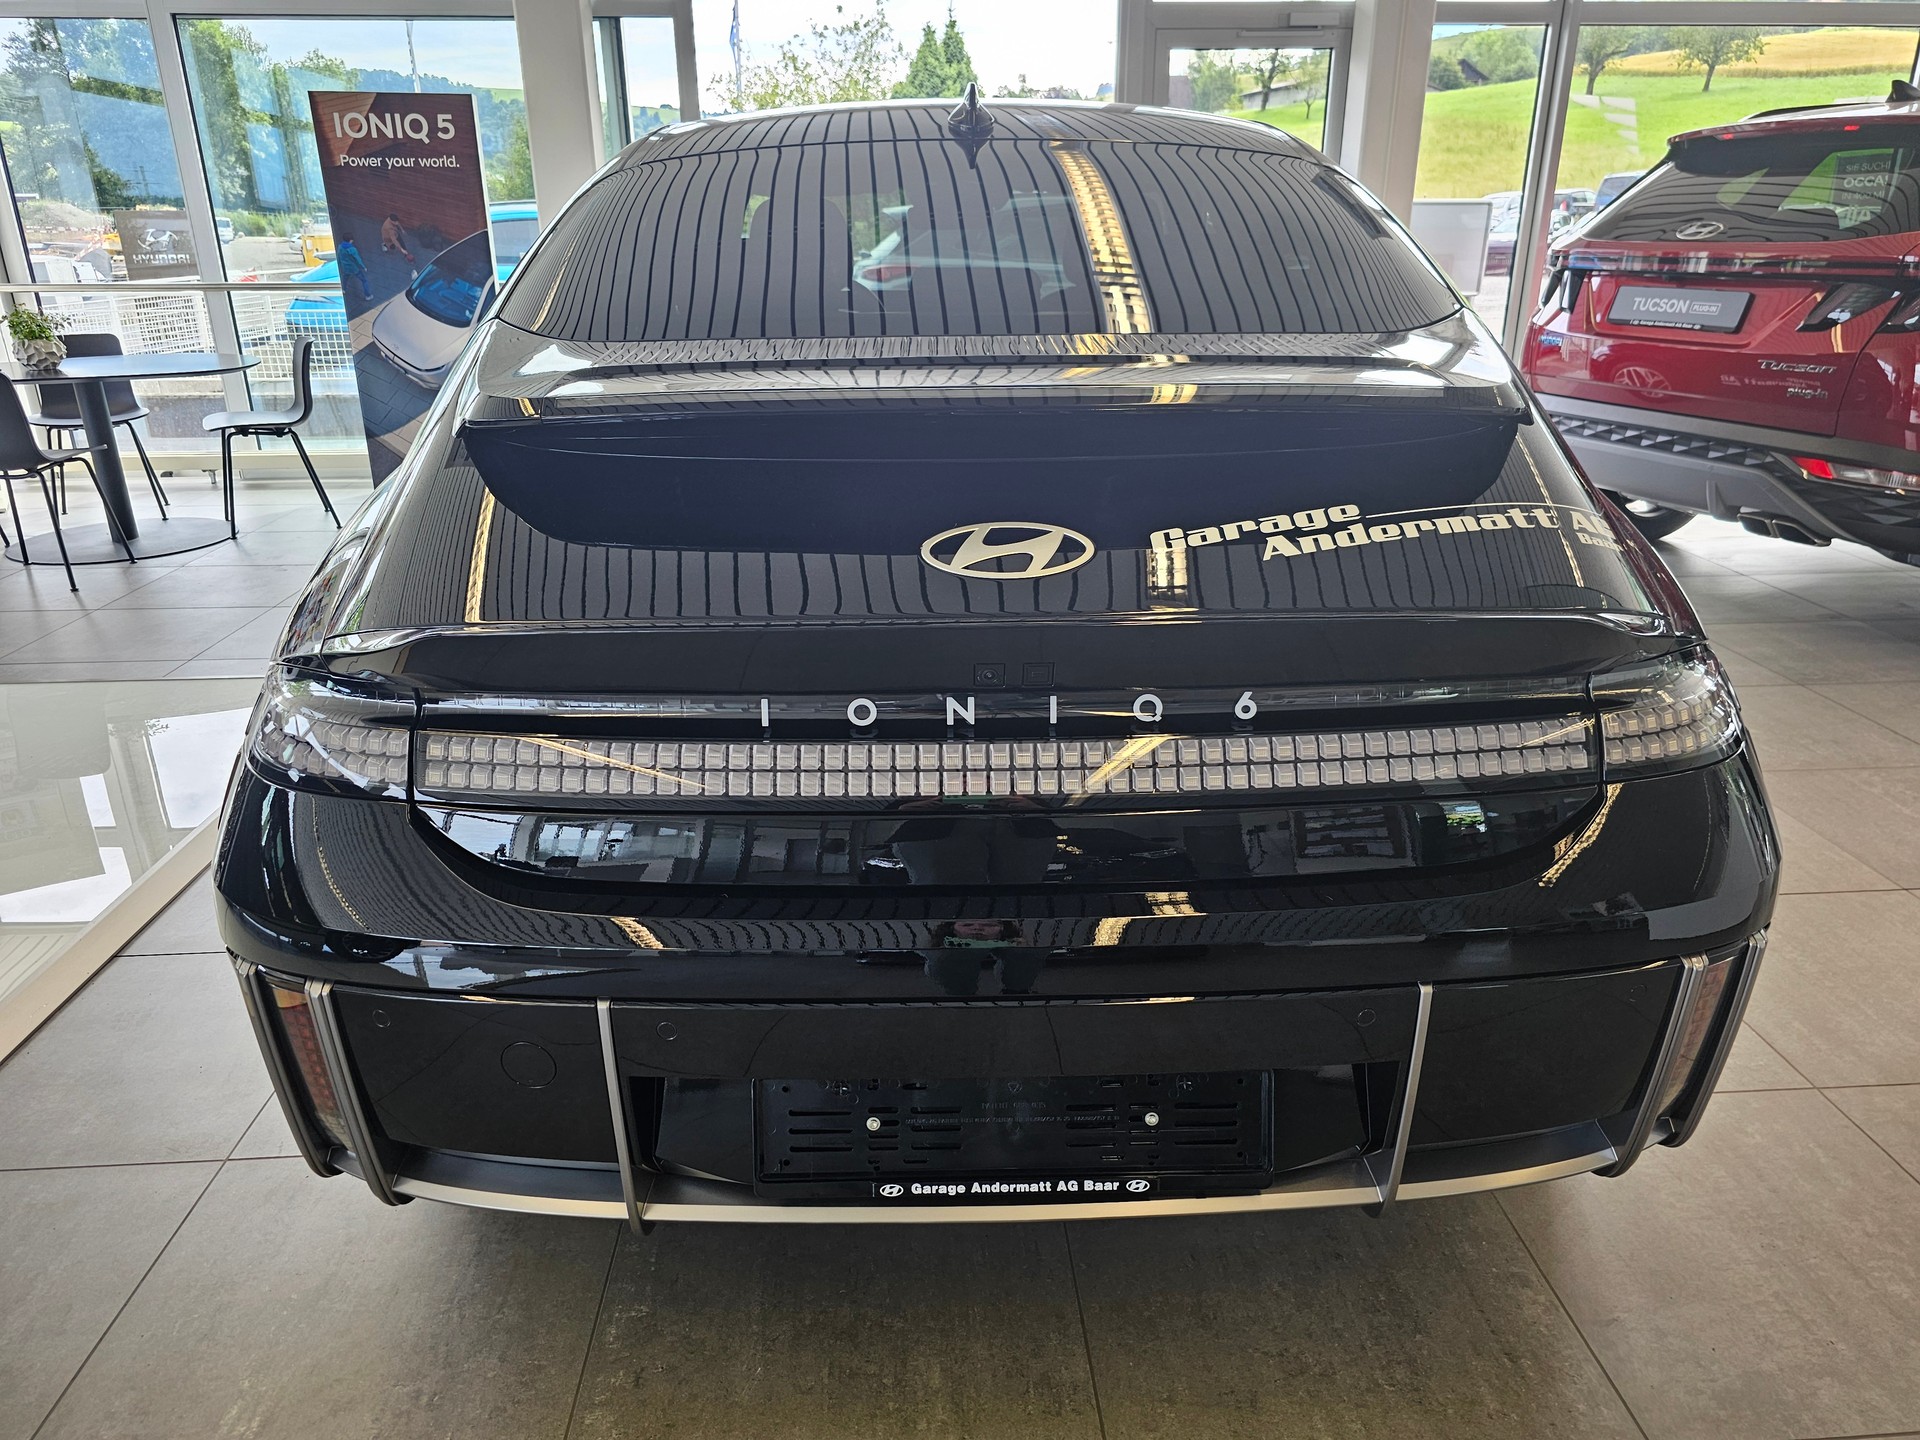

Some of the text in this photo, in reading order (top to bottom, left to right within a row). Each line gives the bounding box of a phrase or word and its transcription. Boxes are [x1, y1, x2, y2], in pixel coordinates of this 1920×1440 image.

[333, 112, 455, 144] IONIQ 5
[340, 154, 460, 169] Power your world.
[132, 254, 191, 264] HYUNDAI
[1632, 297, 1718, 314] TUCSON PLUG-IN
[1150, 504, 1362, 552] Garage
[1262, 508, 1560, 561] Andermatt
[1234, 691, 1258, 720] 6
[911, 1180, 1120, 1196] Garage Andermatt AG Baar
